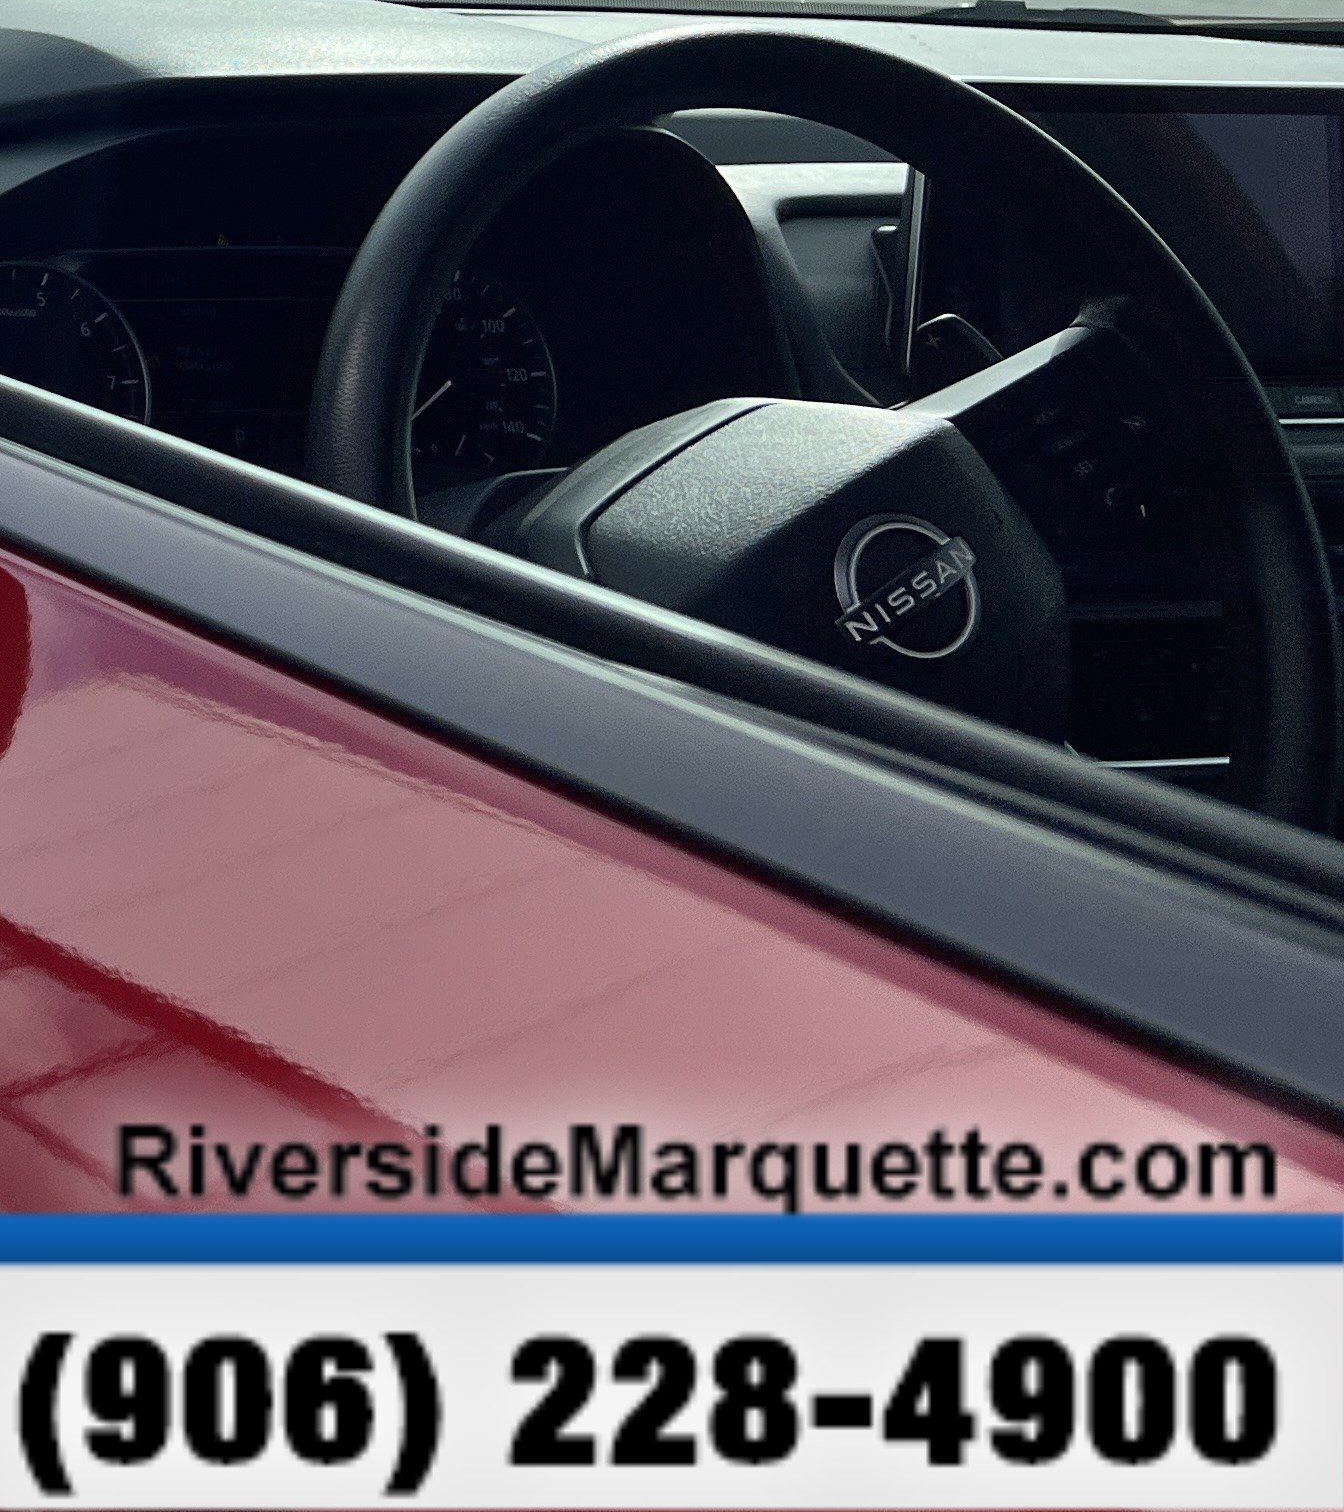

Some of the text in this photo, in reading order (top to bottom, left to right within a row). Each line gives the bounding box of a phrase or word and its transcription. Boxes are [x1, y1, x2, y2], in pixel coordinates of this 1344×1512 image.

[36, 291, 47, 307] 5
[80, 322, 92, 337] 6
[482, 319, 505, 333] 100
[843, 539, 975, 642] NISSAN
